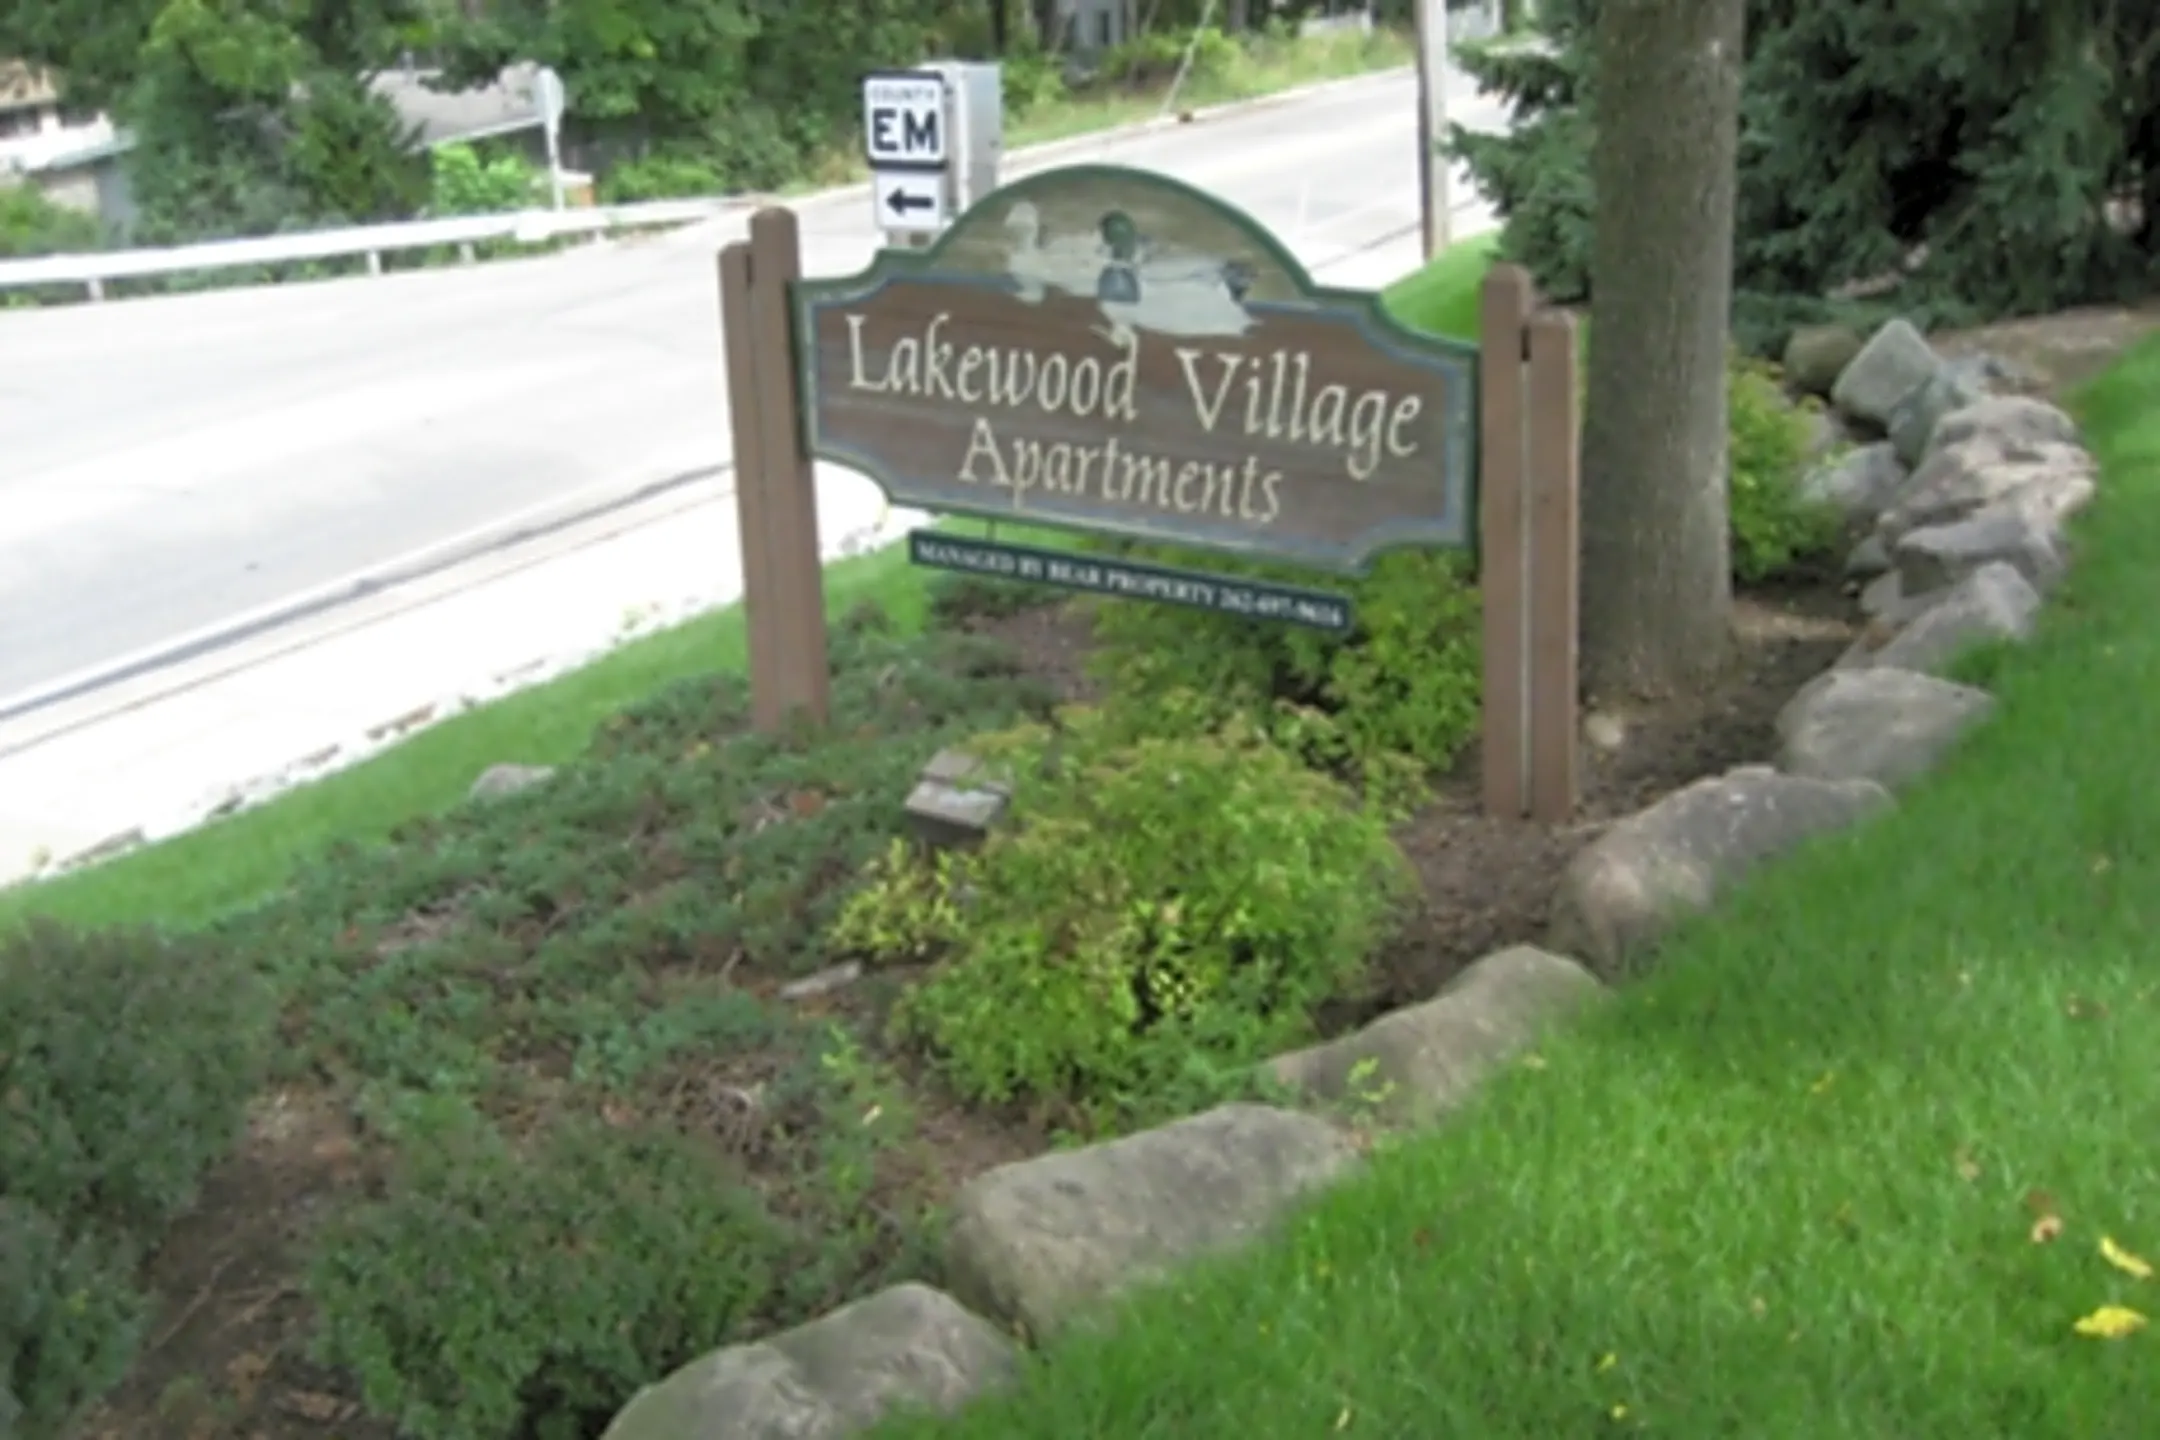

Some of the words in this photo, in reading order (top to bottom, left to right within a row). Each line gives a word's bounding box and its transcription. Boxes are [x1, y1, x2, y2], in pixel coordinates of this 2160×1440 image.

[872, 107, 940, 154] EM
[844, 311, 1139, 422] Lakewood
[1174, 346, 1423, 480] Village
[957, 416, 1284, 524] Apartments
[915, 539, 1016, 574] MANAGED
[1017, 554, 1043, 580] BY
[1106, 568, 1214, 606] PROPERTY
